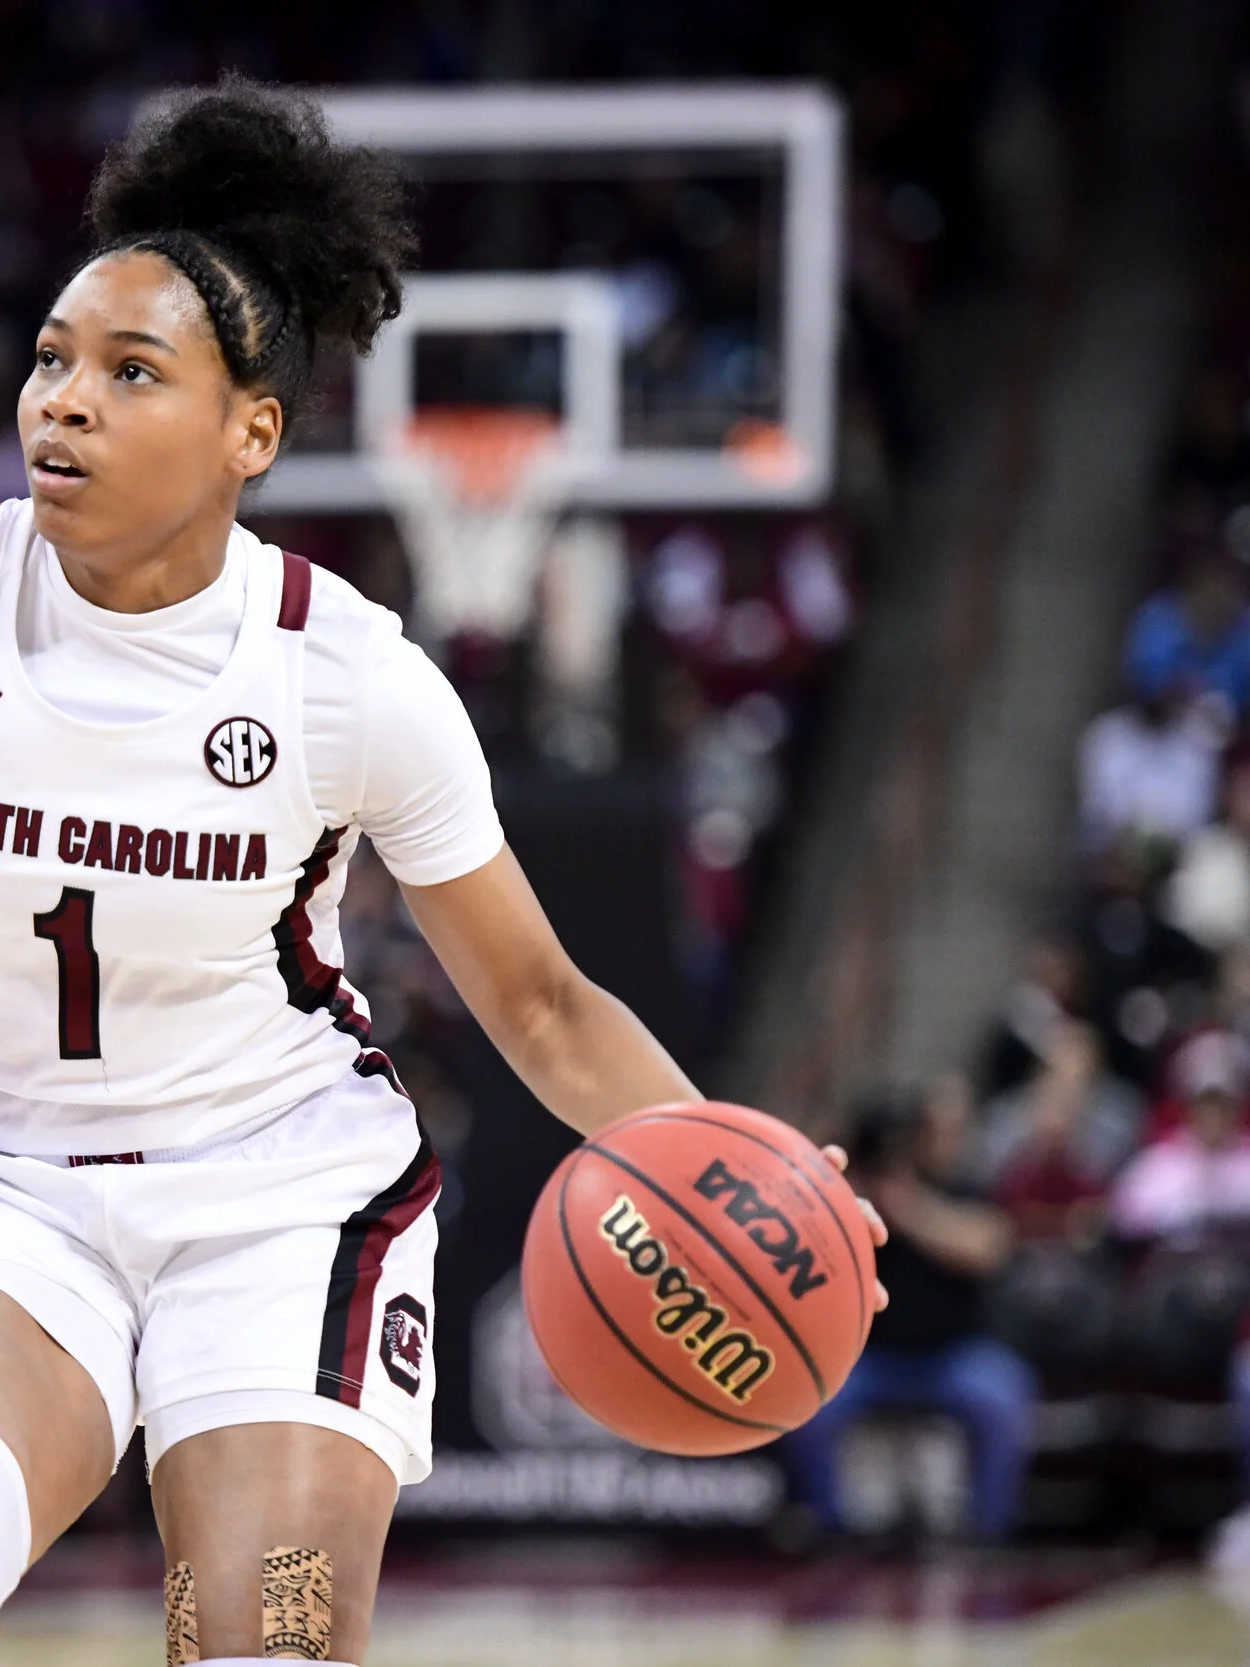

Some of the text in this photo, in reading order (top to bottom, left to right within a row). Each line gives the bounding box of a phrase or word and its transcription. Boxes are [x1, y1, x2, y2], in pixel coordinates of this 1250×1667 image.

[209, 720, 271, 784] SEC
[57, 816, 268, 882] CAROLINA
[33, 885, 102, 1061] 1
[599, 1195, 775, 1404] Wilson
[693, 1158, 828, 1301] NCAA
